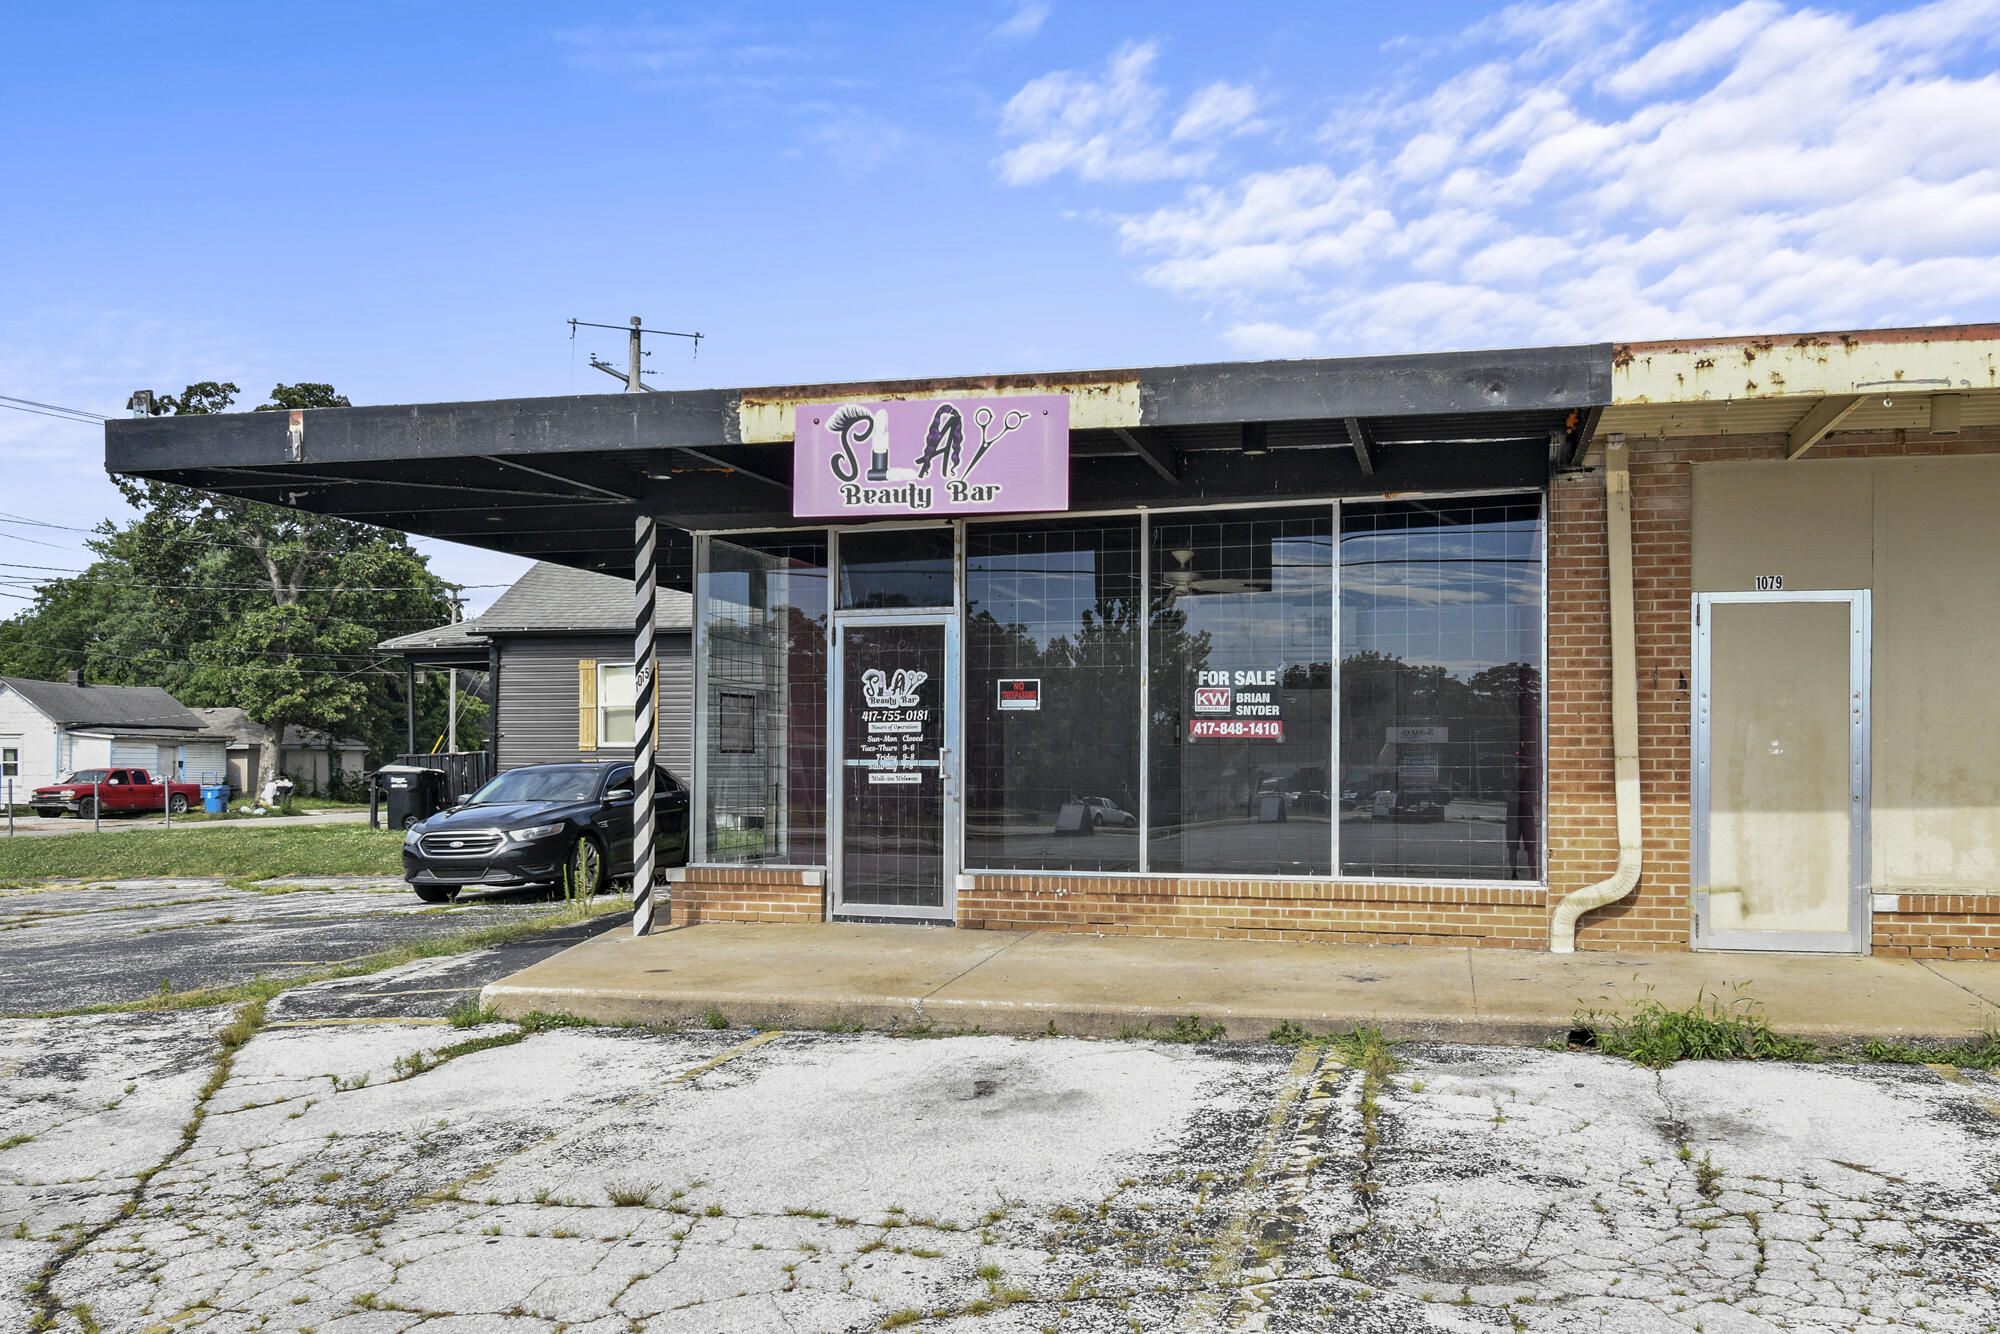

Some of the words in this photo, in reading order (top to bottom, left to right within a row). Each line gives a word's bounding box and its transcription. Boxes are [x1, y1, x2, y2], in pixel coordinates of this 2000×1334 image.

[840, 483, 932, 508] Beauty
[947, 481, 1000, 502] Bar
[1756, 576, 1782, 590] 1079
[1198, 670, 1230, 686] FOR
[1234, 670, 1276, 686] SALE
[1013, 682, 1025, 690] NO
[868, 697, 897, 706] Beauty
[901, 696, 918, 704] Bar
[1197, 692, 1229, 706] KW
[1236, 692, 1271, 703] BRIAN
[861, 710, 928, 722] 417-755-0181
[1236, 705, 1280, 716] SNYDER
[1194, 722, 1279, 735] 417-848-1410
[867, 735, 898, 743] Sun-Mon
[902, 734, 924, 742] Closed
